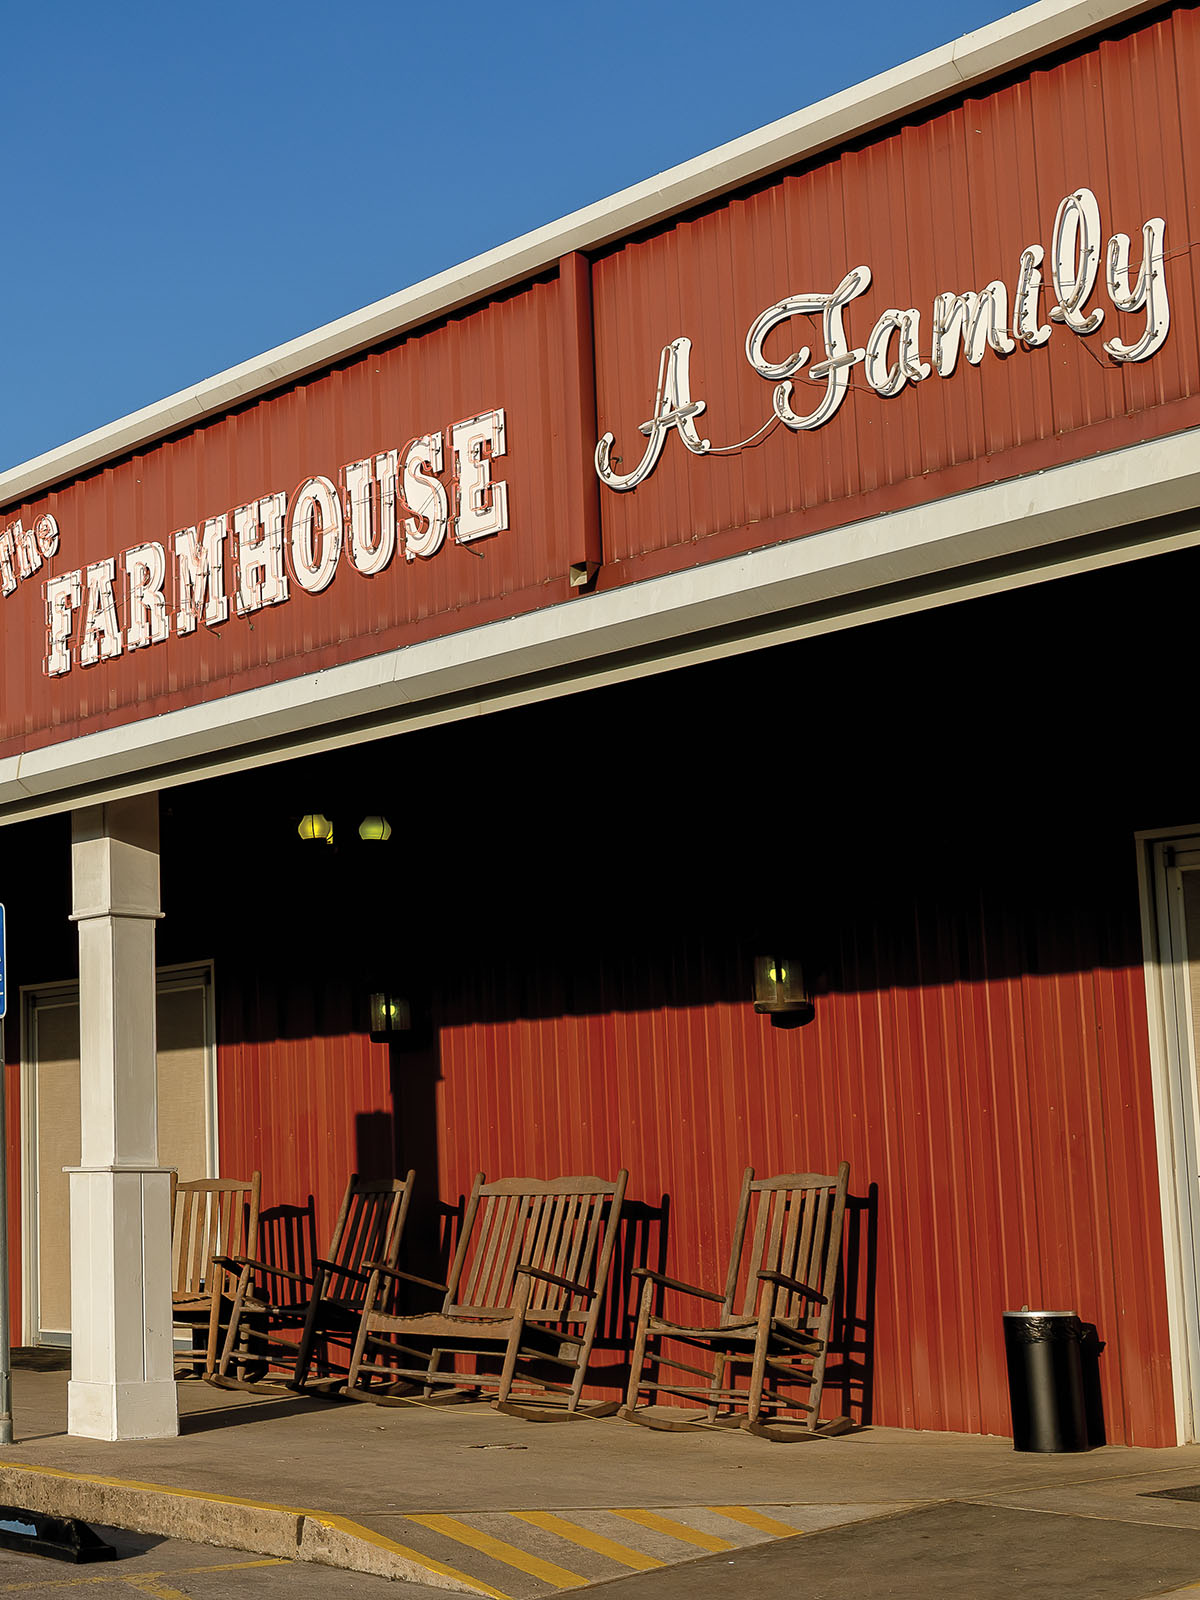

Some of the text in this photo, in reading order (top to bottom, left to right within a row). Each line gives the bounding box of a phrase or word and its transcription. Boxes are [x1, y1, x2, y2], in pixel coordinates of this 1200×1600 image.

[594, 187, 1171, 490] A Family
[41, 407, 510, 679] FARMHOUSE
